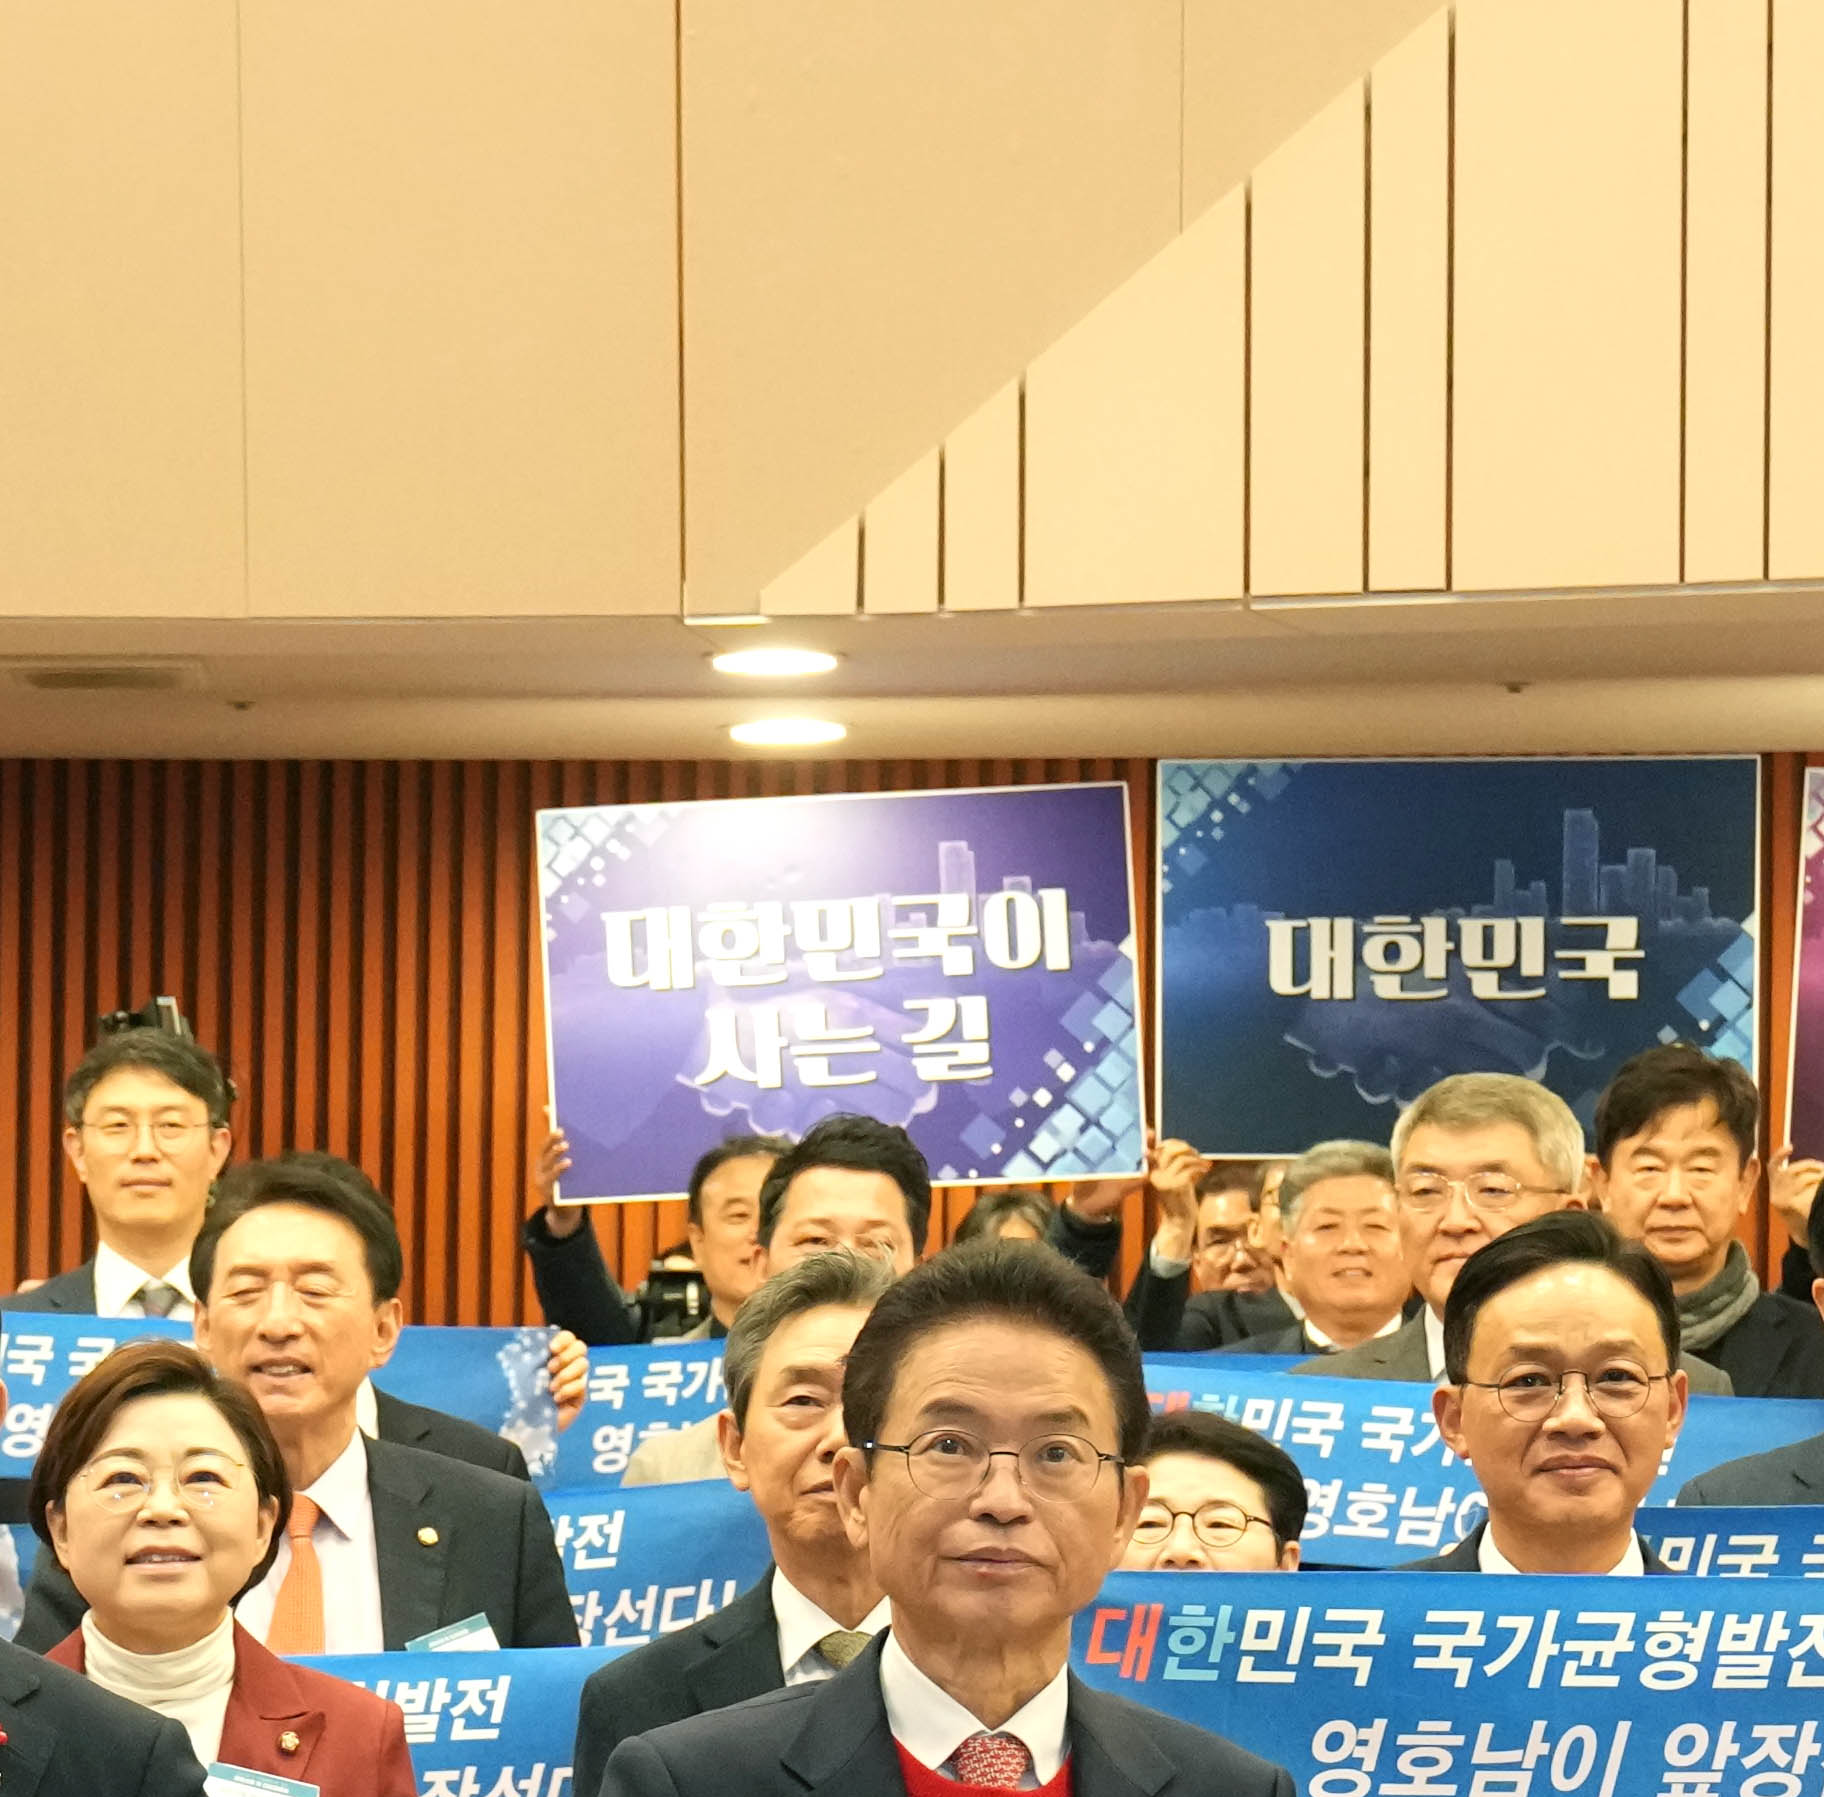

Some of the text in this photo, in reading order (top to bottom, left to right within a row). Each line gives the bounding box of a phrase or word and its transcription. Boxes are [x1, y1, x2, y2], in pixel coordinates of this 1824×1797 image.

[602, 886, 1071, 992] 대한민국이
[1266, 915, 1645, 1000] 대한민국
[698, 996, 994, 1092] 사는 길
[1085, 1604, 1386, 1690] 대한민국
